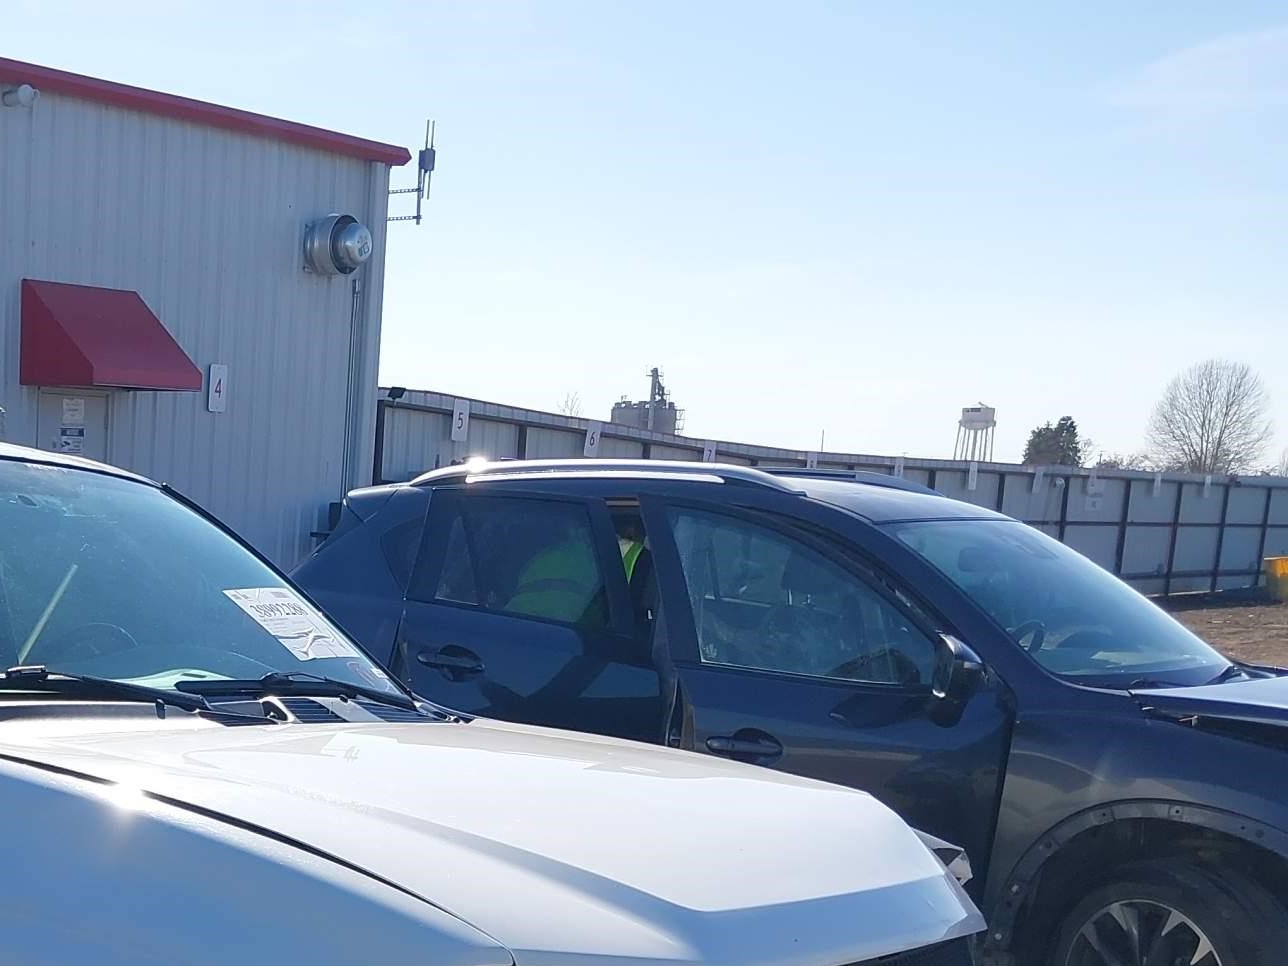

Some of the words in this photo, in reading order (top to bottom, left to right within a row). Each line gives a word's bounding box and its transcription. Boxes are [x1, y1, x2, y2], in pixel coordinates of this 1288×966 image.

[214, 378, 222, 399] 4
[457, 412, 464, 430] 5
[589, 431, 596, 447] 6
